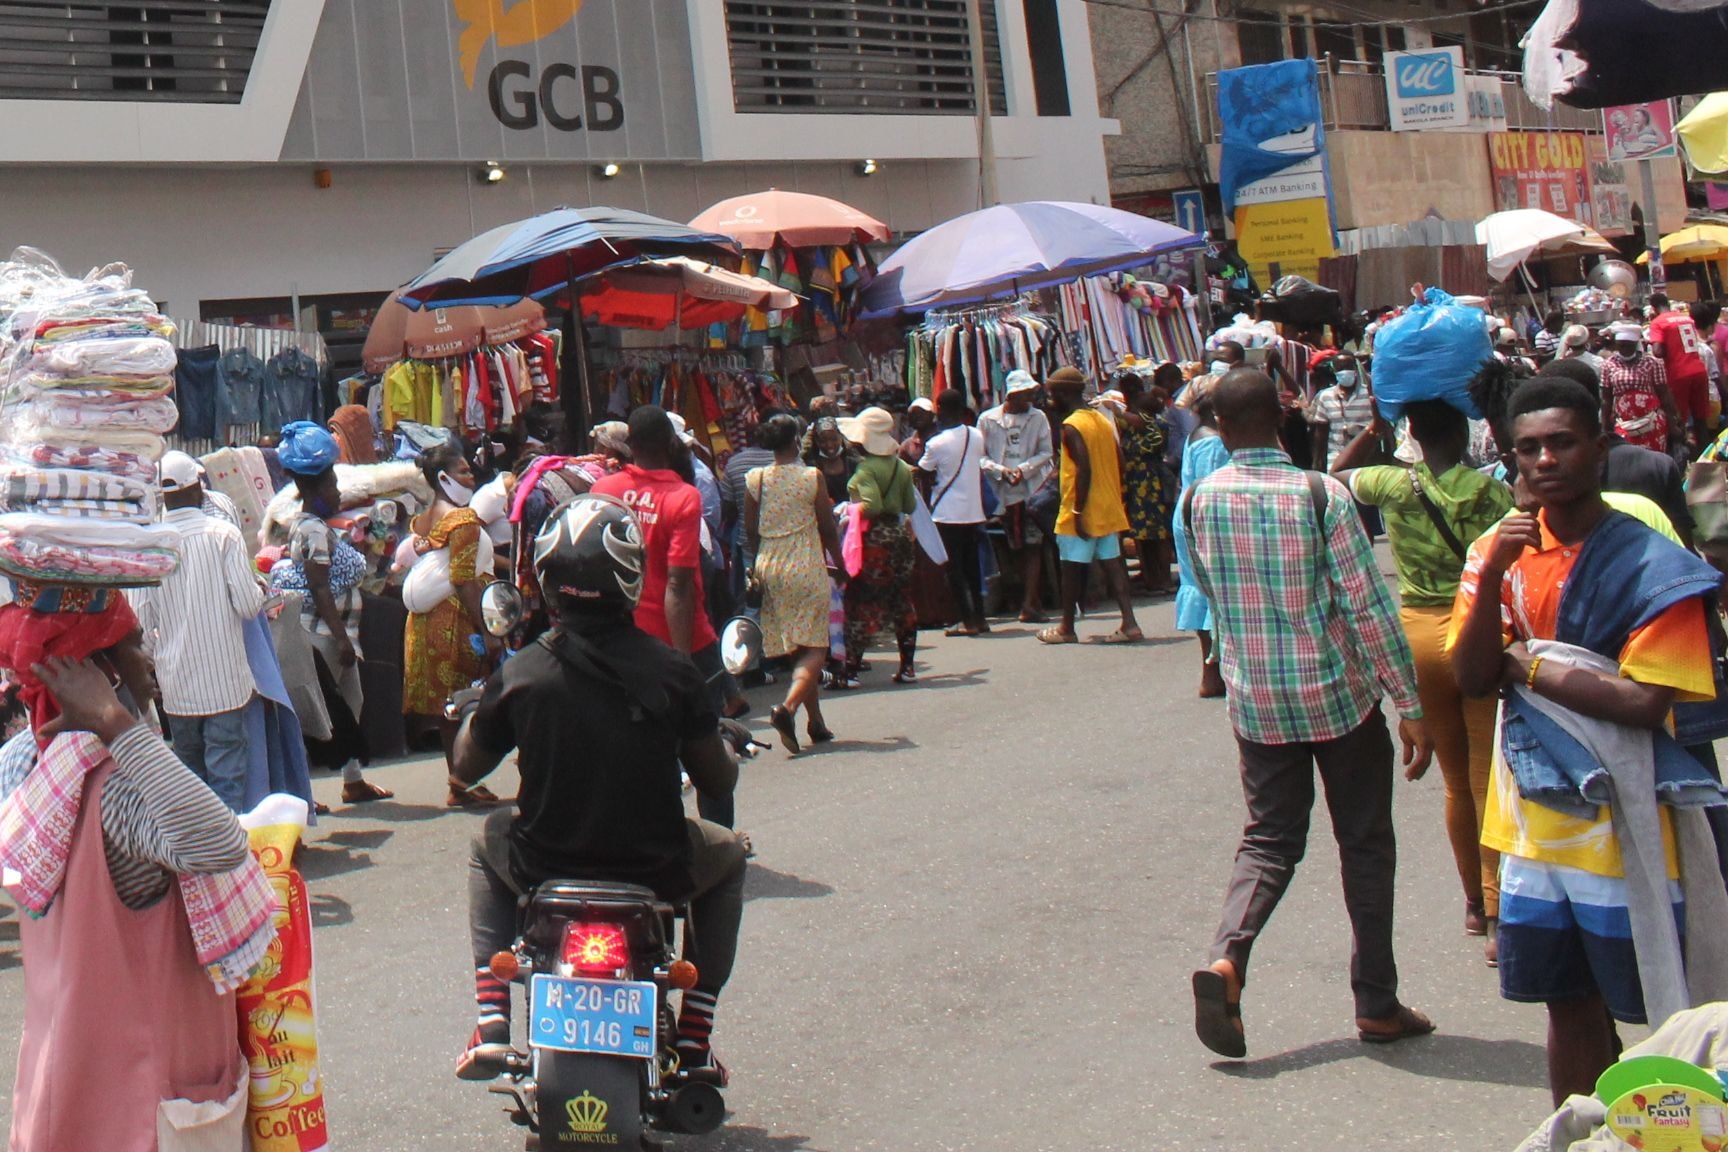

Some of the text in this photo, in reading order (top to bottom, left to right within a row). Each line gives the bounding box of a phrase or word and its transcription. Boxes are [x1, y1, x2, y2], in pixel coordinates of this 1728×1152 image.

[488, 59, 624, 132] GCB
[1492, 133, 1585, 170] CITY GOLD
[1258, 184, 1277, 196] ATM
[1280, 182, 1317, 193] Banking
[434, 324, 453, 334] cash
[623, 489, 655, 509] O.A.
[545, 981, 642, 1015] M-20-GR
[563, 1018, 621, 1047] 9146
[633, 1041, 649, 1053] GH
[255, 1104, 325, 1141] Coffee
[558, 1131, 618, 1145] MOTORCYCLE
